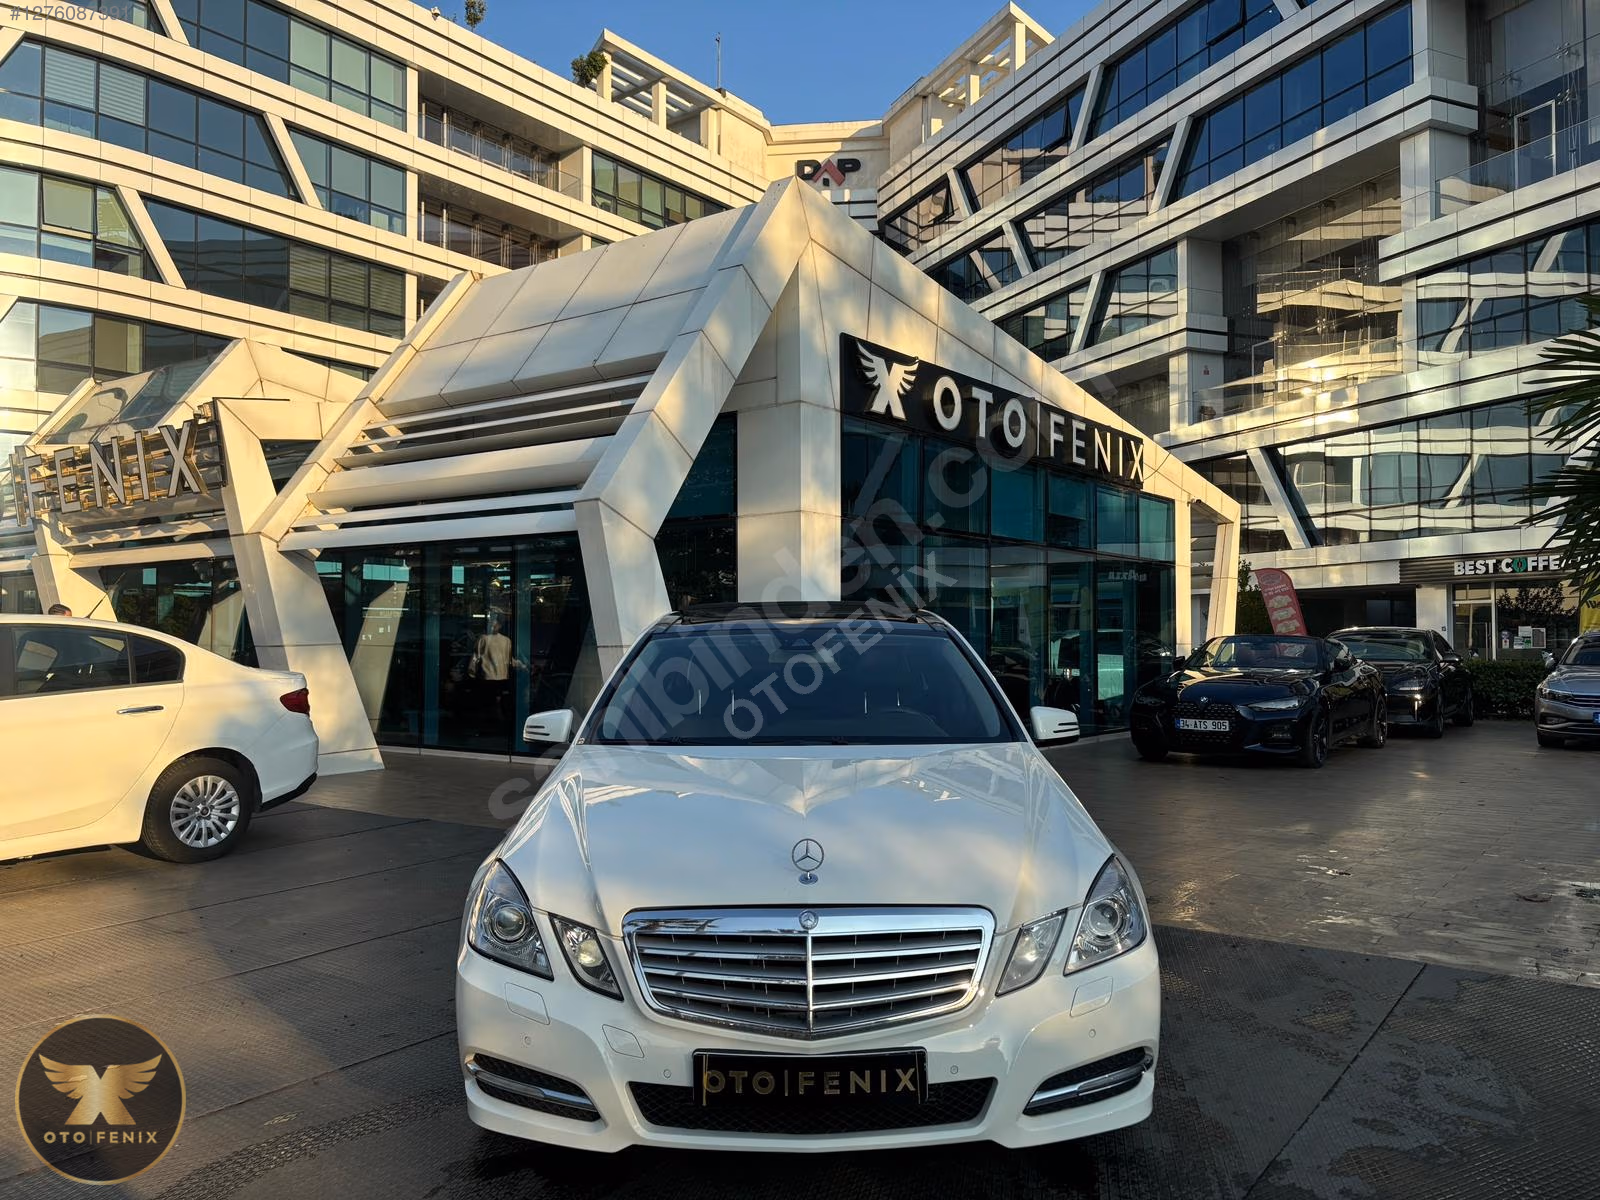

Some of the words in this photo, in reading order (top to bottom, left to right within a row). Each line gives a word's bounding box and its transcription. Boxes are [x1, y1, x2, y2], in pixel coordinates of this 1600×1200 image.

[933, 376, 1027, 448] OTO
[1050, 412, 1145, 482] FENIX
[23, 419, 202, 519] FENIX
[1454, 559, 1497, 576] BEST
[1501, 554, 1573, 574] COFFE
[1180, 719, 1190, 729] 34
[1194, 720, 1208, 730] ATS
[1212, 721, 1227, 730] 905
[703, 1069, 775, 1095] OTO
[799, 1067, 916, 1095] FENIX
